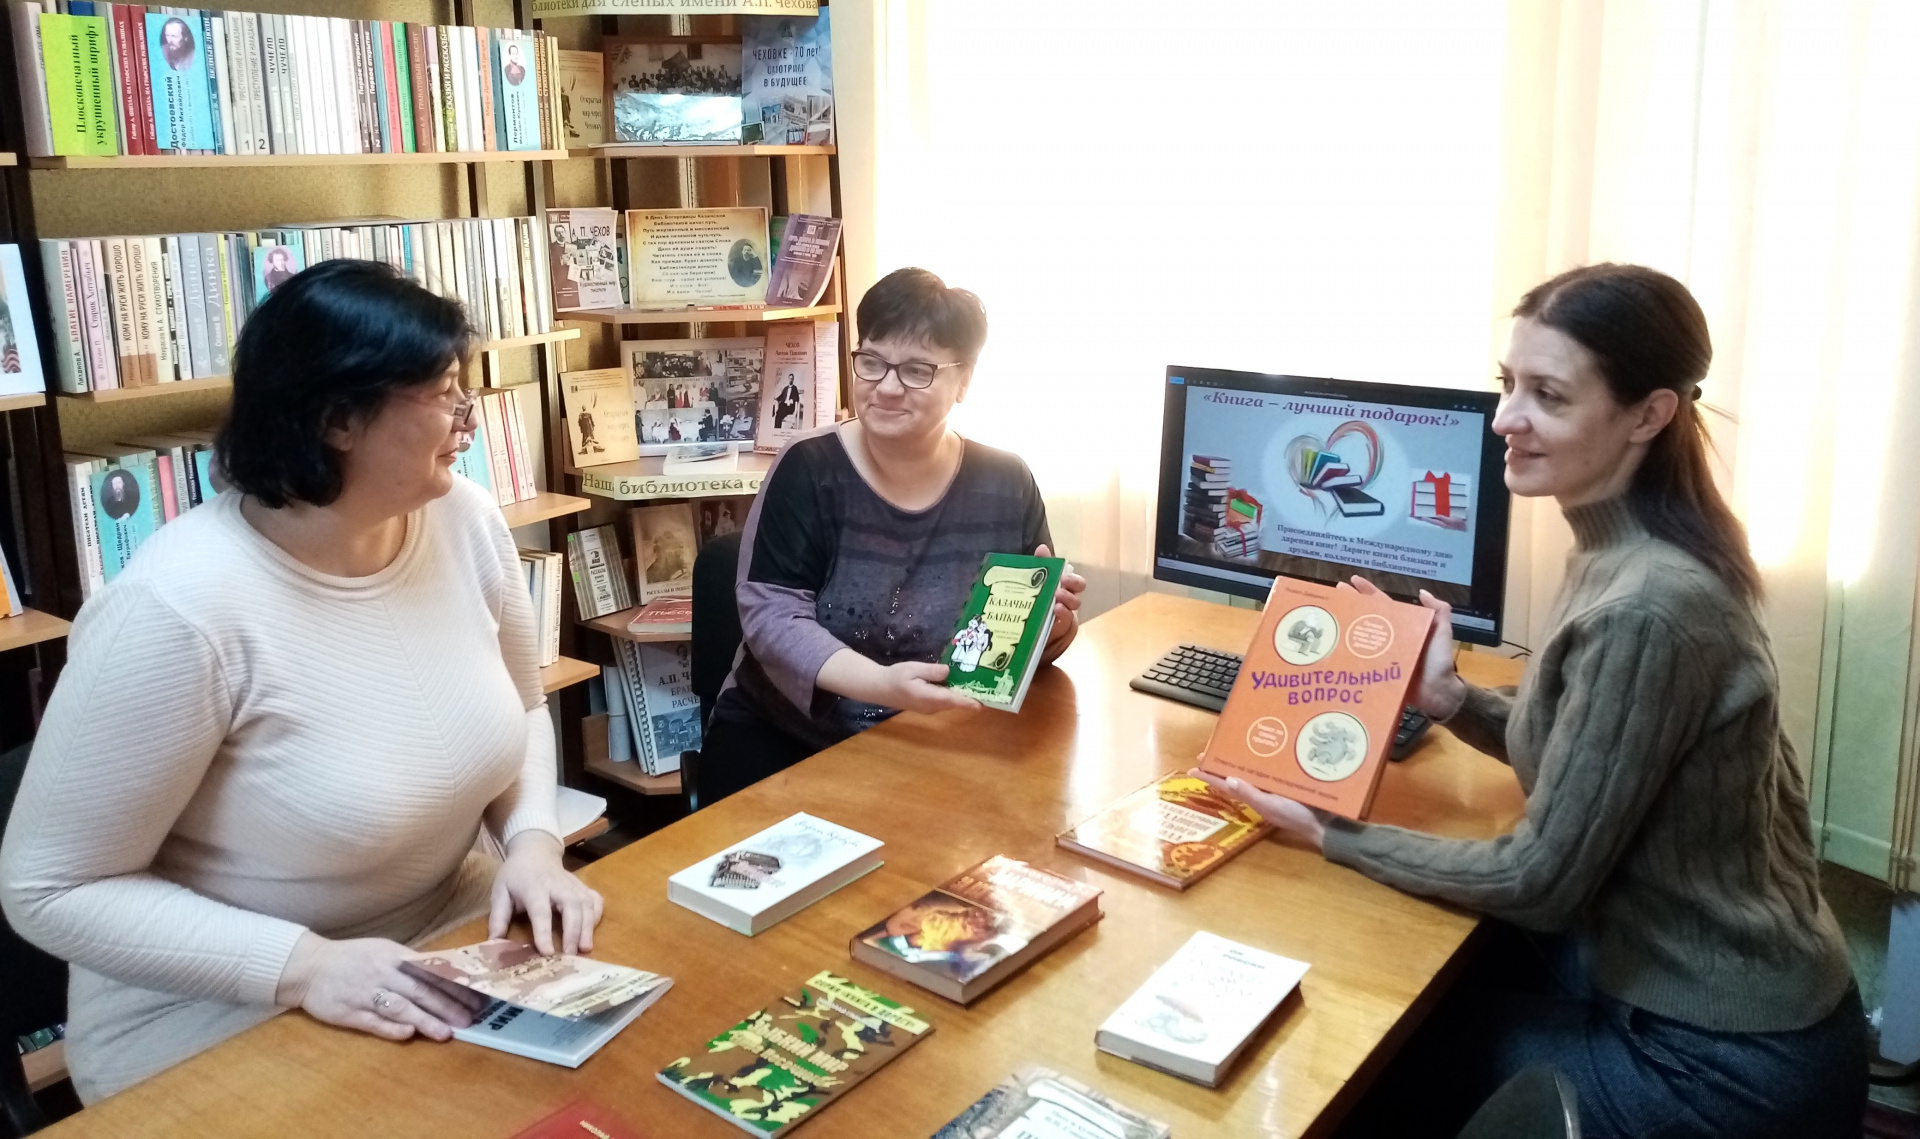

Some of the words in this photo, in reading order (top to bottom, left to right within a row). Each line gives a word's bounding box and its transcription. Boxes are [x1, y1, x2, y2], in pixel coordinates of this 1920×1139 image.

[582, 0, 607, 9] для
[776, 0, 817, 9] Чехова
[87, 25, 100, 63] шрифт
[232, 17, 241, 50] НАКАЗАНИЕ
[246, 17, 256, 50] НАКАЗАНИЕ
[266, 37, 276, 74] ЧУЧЕЛО
[278, 38, 288, 74] ЧУЧЕЛО
[353, 32, 362, 67] открытие
[364, 31, 373, 66] открытие
[441, 34, 450, 72] РАССКАЗЫ
[753, 48, 787, 60] ЧЕХОВКЕ
[795, 47, 804, 57] 70
[236, 58, 246, 101] ПРЕСТУПЛЕНИЕ
[251, 57, 261, 101] ПРЕСТУПЛЕНИЕ
[368, 68, 376, 94] Первое
[541, 38, 549, 96] СТИХОТВОРЕНИЯ
[768, 64, 804, 74] СМОТРИМ
[69, 35, 86, 133] Плоскопечатный
[414, 63, 424, 110] ГРАНАТОВЫЙ
[764, 79, 768, 87] В
[771, 77, 807, 88] БУДУЩЕЕ
[88, 68, 107, 145] укрупненный
[165, 76, 179, 149] Достоевский
[510, 93, 518, 143] Лермонтов
[259, 139, 266, 150] 2
[376, 139, 381, 147] 2
[590, 226, 610, 236] ЧЕХОВ
[113, 245, 123, 273] ХОРОШО
[132, 245, 141, 272] ХОРОШО
[61, 250, 73, 303] НАМЕРЕНИЯ
[84, 262, 95, 299] Хоттабыч
[116, 275, 126, 293] ЖИТЬ
[135, 274, 144, 292] ЖИТЬ
[151, 262, 162, 315] СТИХОТВОРЕНИЯ
[186, 248, 202, 308] Динка
[205, 247, 221, 307] Динка
[90, 301, 99, 328] Старик
[118, 295, 127, 311] РУСИ
[137, 294, 145, 310] РУСИ
[139, 311, 146, 320] НА
[69, 309, 79, 342] БЛАГИЕ
[121, 313, 129, 322] НА
[140, 322, 150, 339] КОМУ
[122, 323, 131, 341] КОМУ
[213, 325, 222, 347] Осеева
[158, 333, 167, 360] Некрасов
[75, 358, 84, 386] Лиханов
[1204, 392, 1264, 408] «Книга
[1282, 401, 1355, 417] лучший
[1360, 408, 1460, 427] подарок!»
[620, 478, 743, 495] библиотека
[115, 522, 123, 550] Щедрин
[123, 524, 131, 560] Евграфович
[1278, 525, 1347, 541] Присоединяйтесь
[1357, 537, 1431, 556] Международному
[1282, 536, 1314, 545] дарения
[1316, 541, 1338, 549] книг!
[1341, 545, 1371, 556] Дарите
[1373, 549, 1398, 560] книги
[1400, 555, 1438, 566] близким
[1288, 546, 1322, 557] друзьям,
[1324, 553, 1361, 564] коллегам
[989, 597, 1032, 609] КАЗАЧЬИ
[987, 612, 1021, 623] БАЙКИ
[658, 674, 680, 686] А.П.
[672, 696, 700, 708] РАСЧЕ
